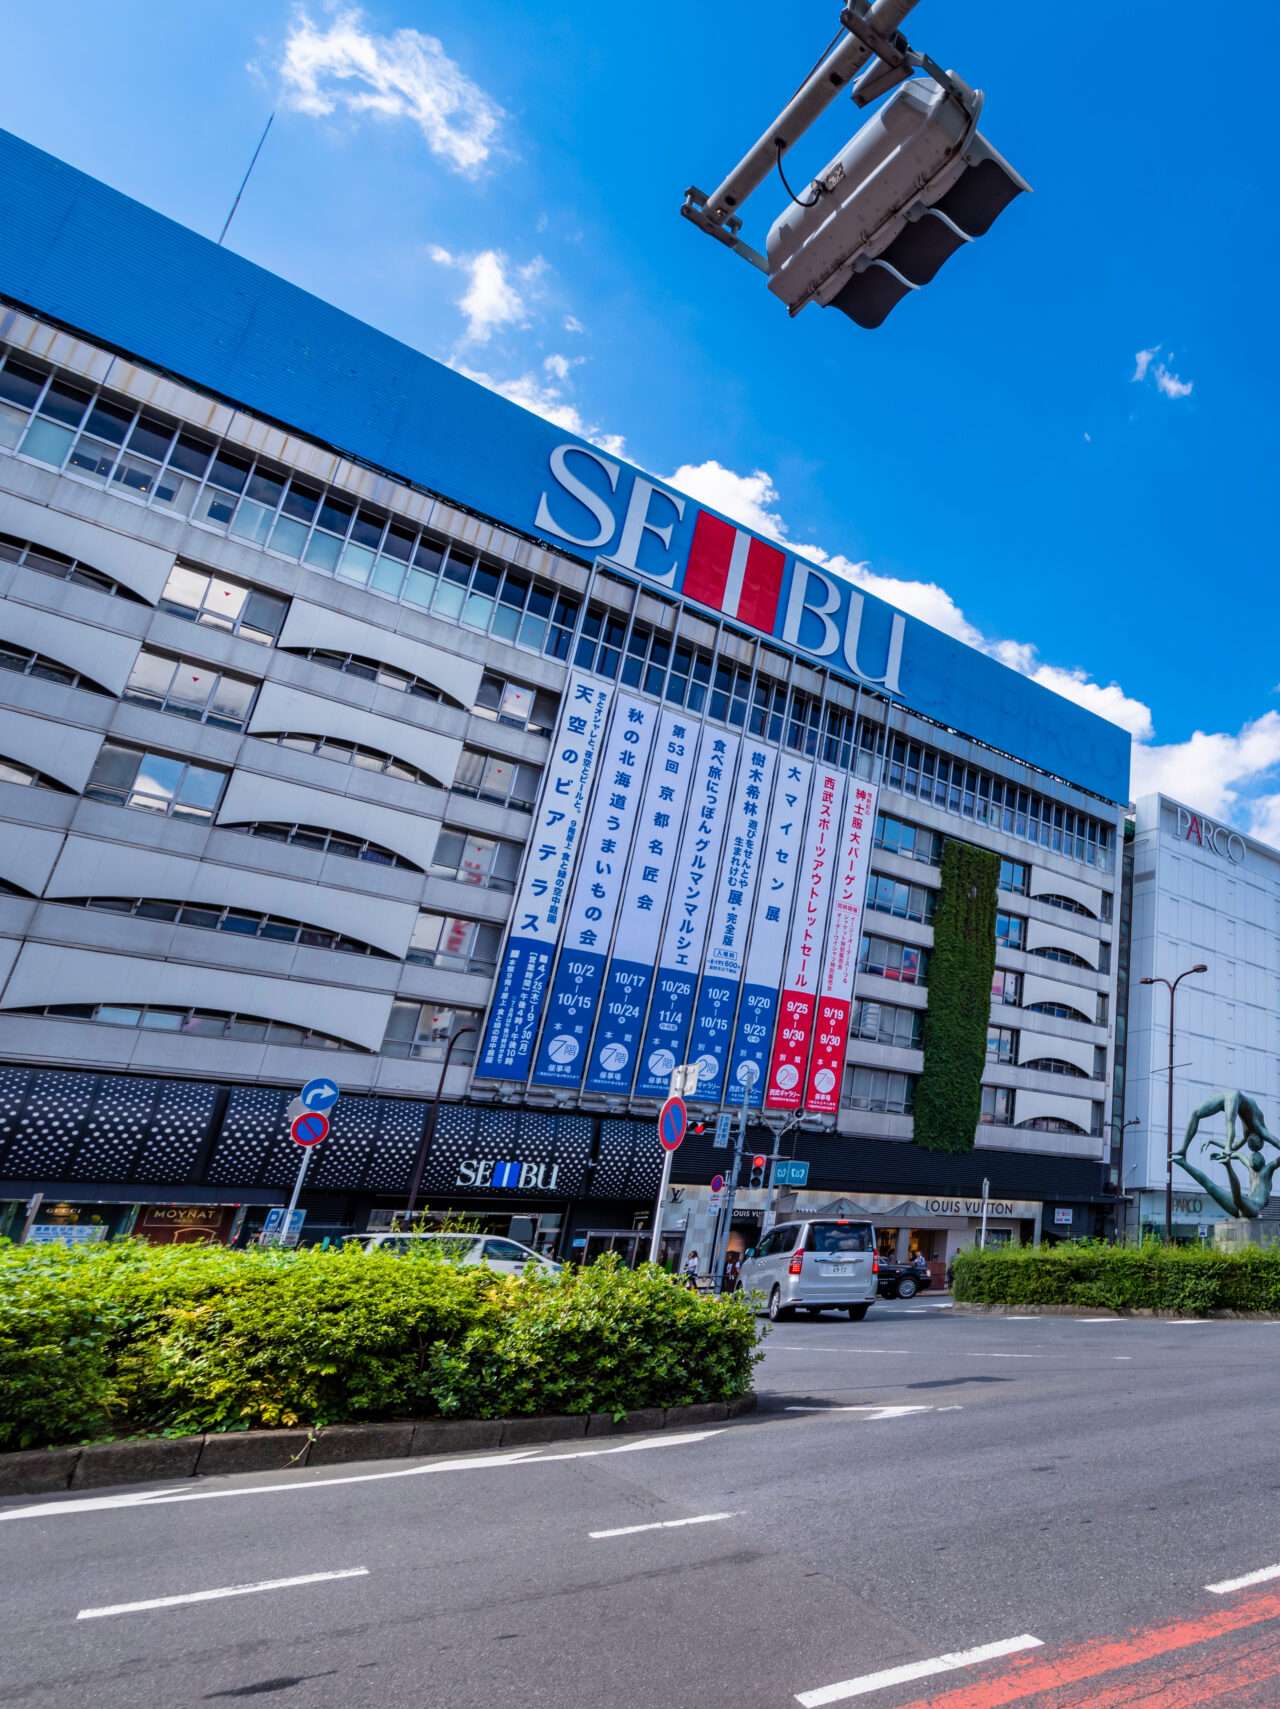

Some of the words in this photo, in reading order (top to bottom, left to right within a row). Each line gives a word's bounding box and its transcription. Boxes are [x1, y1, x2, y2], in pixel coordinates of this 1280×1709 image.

[534, 444, 906, 697] SEIBU
[520, 684, 595, 932] 天空のビアテラス
[579, 708, 644, 946] 秋の北海道うまいもの会
[1175, 807, 1247, 865] PARCO
[765, 767, 802, 922] 大マイセン展
[795, 776, 836, 987] 西武スポーツアウトレットセール
[568, 961, 595, 977] 10/2
[615, 972, 646, 987] 10/17
[661, 980, 691, 995] 10/26
[708, 988, 730, 1001] 10/2
[558, 993, 592, 1009] 10/15
[748, 995, 771, 1008] 9/20
[787, 1002, 808, 1014] 9/25
[608, 1002, 640, 1018] 10/24
[659, 1010, 682, 1024] 11/4
[824, 1008, 844, 1019] 9/19
[701, 1017, 728, 1030] 10/15
[744, 1024, 766, 1036] 9/23
[783, 1029, 804, 1041] 9/30
[820, 1034, 841, 1046] 9/30
[456, 1160, 558, 1190] SEIBU
[925, 1199, 960, 1213] LOUIS
[153, 1209, 217, 1220] MOYNAT
